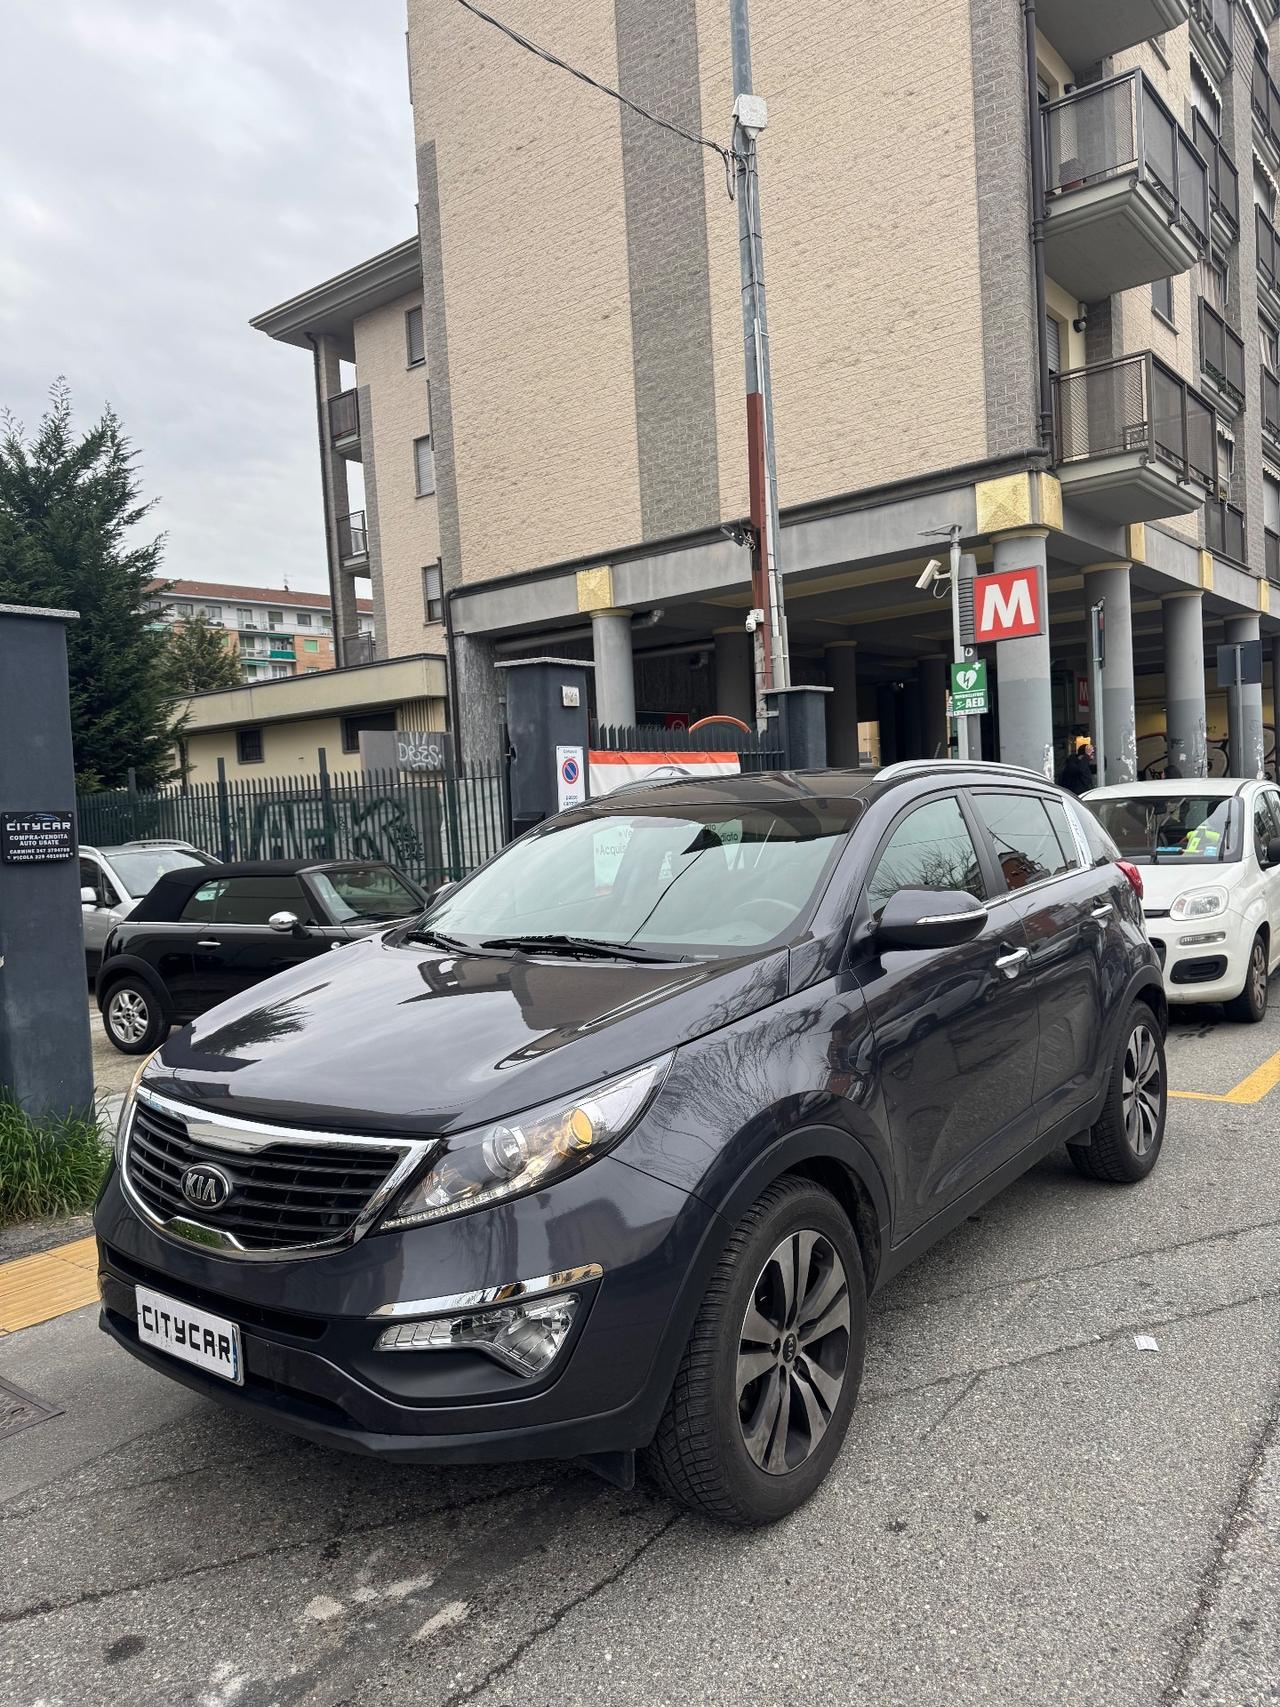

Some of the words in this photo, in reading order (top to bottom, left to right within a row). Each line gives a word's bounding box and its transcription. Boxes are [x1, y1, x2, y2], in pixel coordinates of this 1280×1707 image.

[981, 579, 1035, 632] M
[965, 697, 984, 708] AED
[6, 822, 71, 831] CITYCAR
[186, 1172, 217, 1203] KIA
[142, 1304, 231, 1363] CITYCAR
